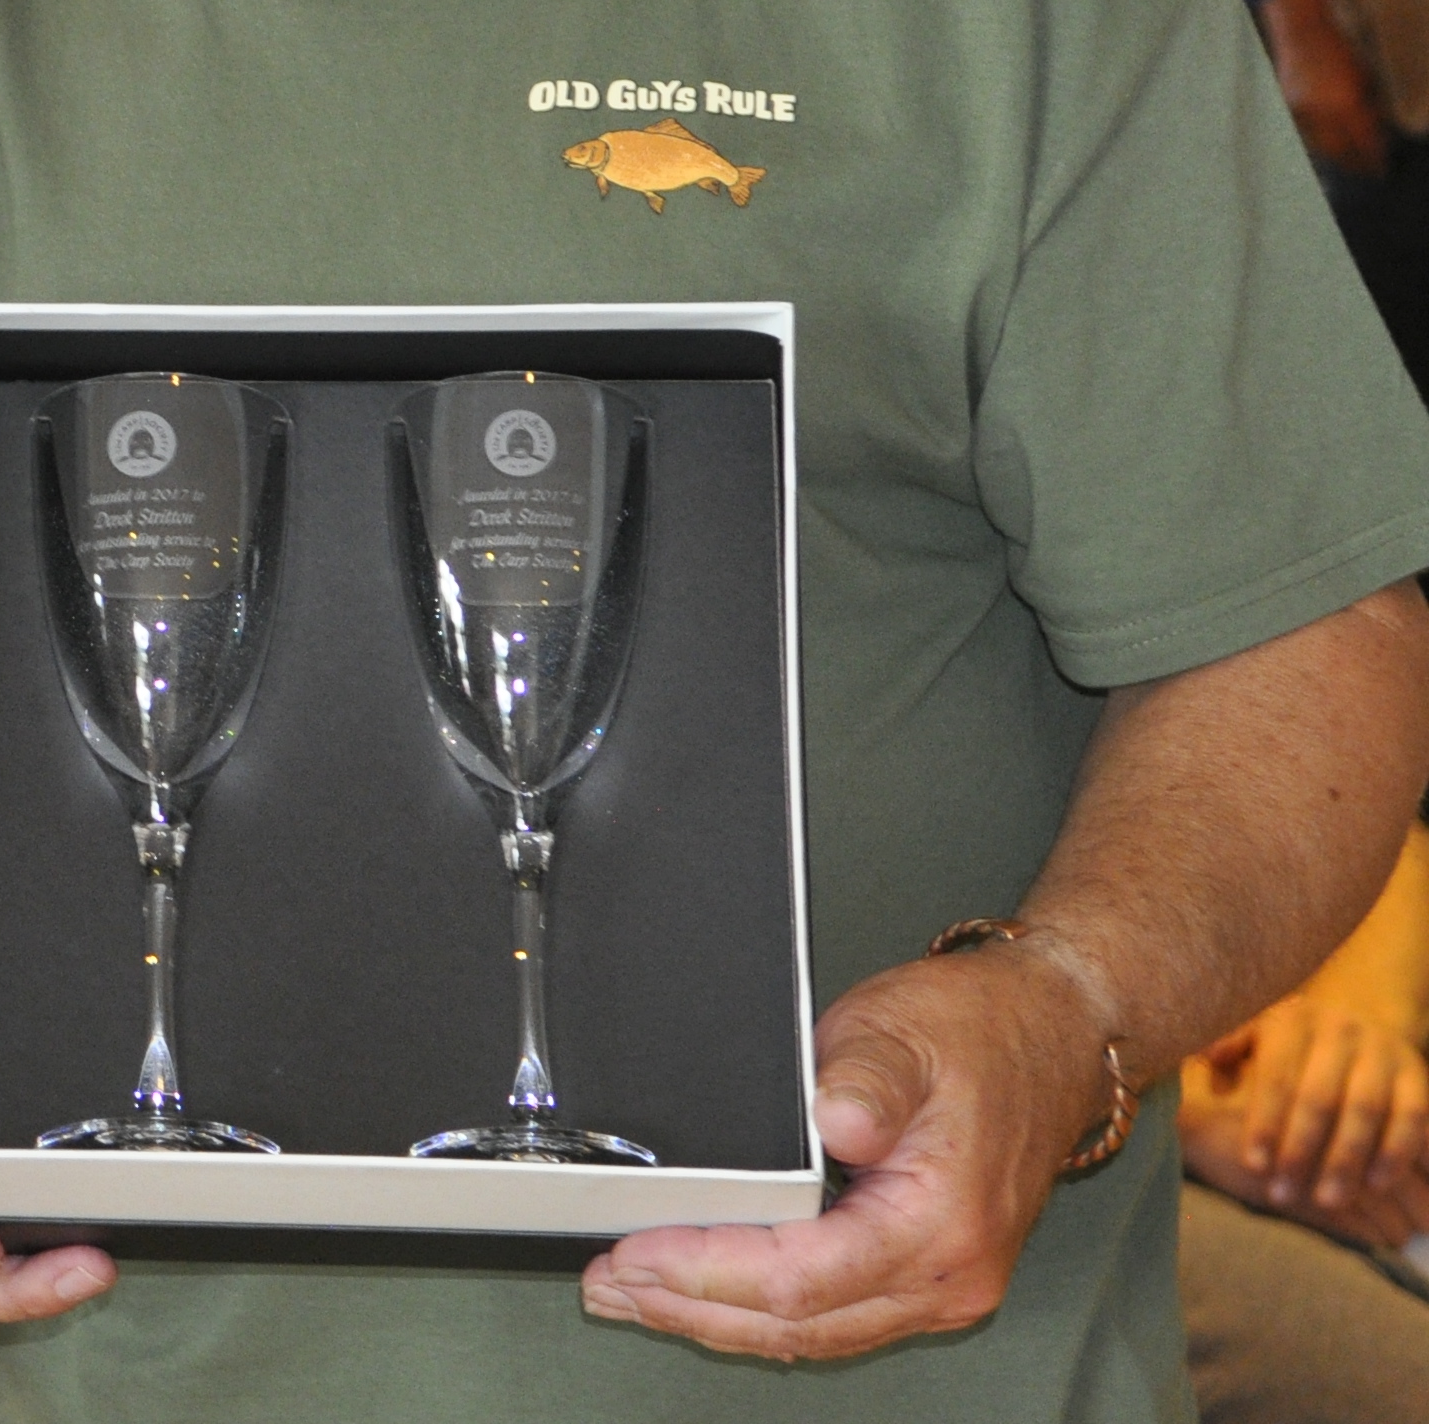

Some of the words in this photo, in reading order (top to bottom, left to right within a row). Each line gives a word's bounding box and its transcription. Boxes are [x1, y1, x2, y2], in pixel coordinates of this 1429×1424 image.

[528, 80, 600, 111] OLD
[607, 79, 697, 112] GUYS
[703, 81, 797, 122] RULE
